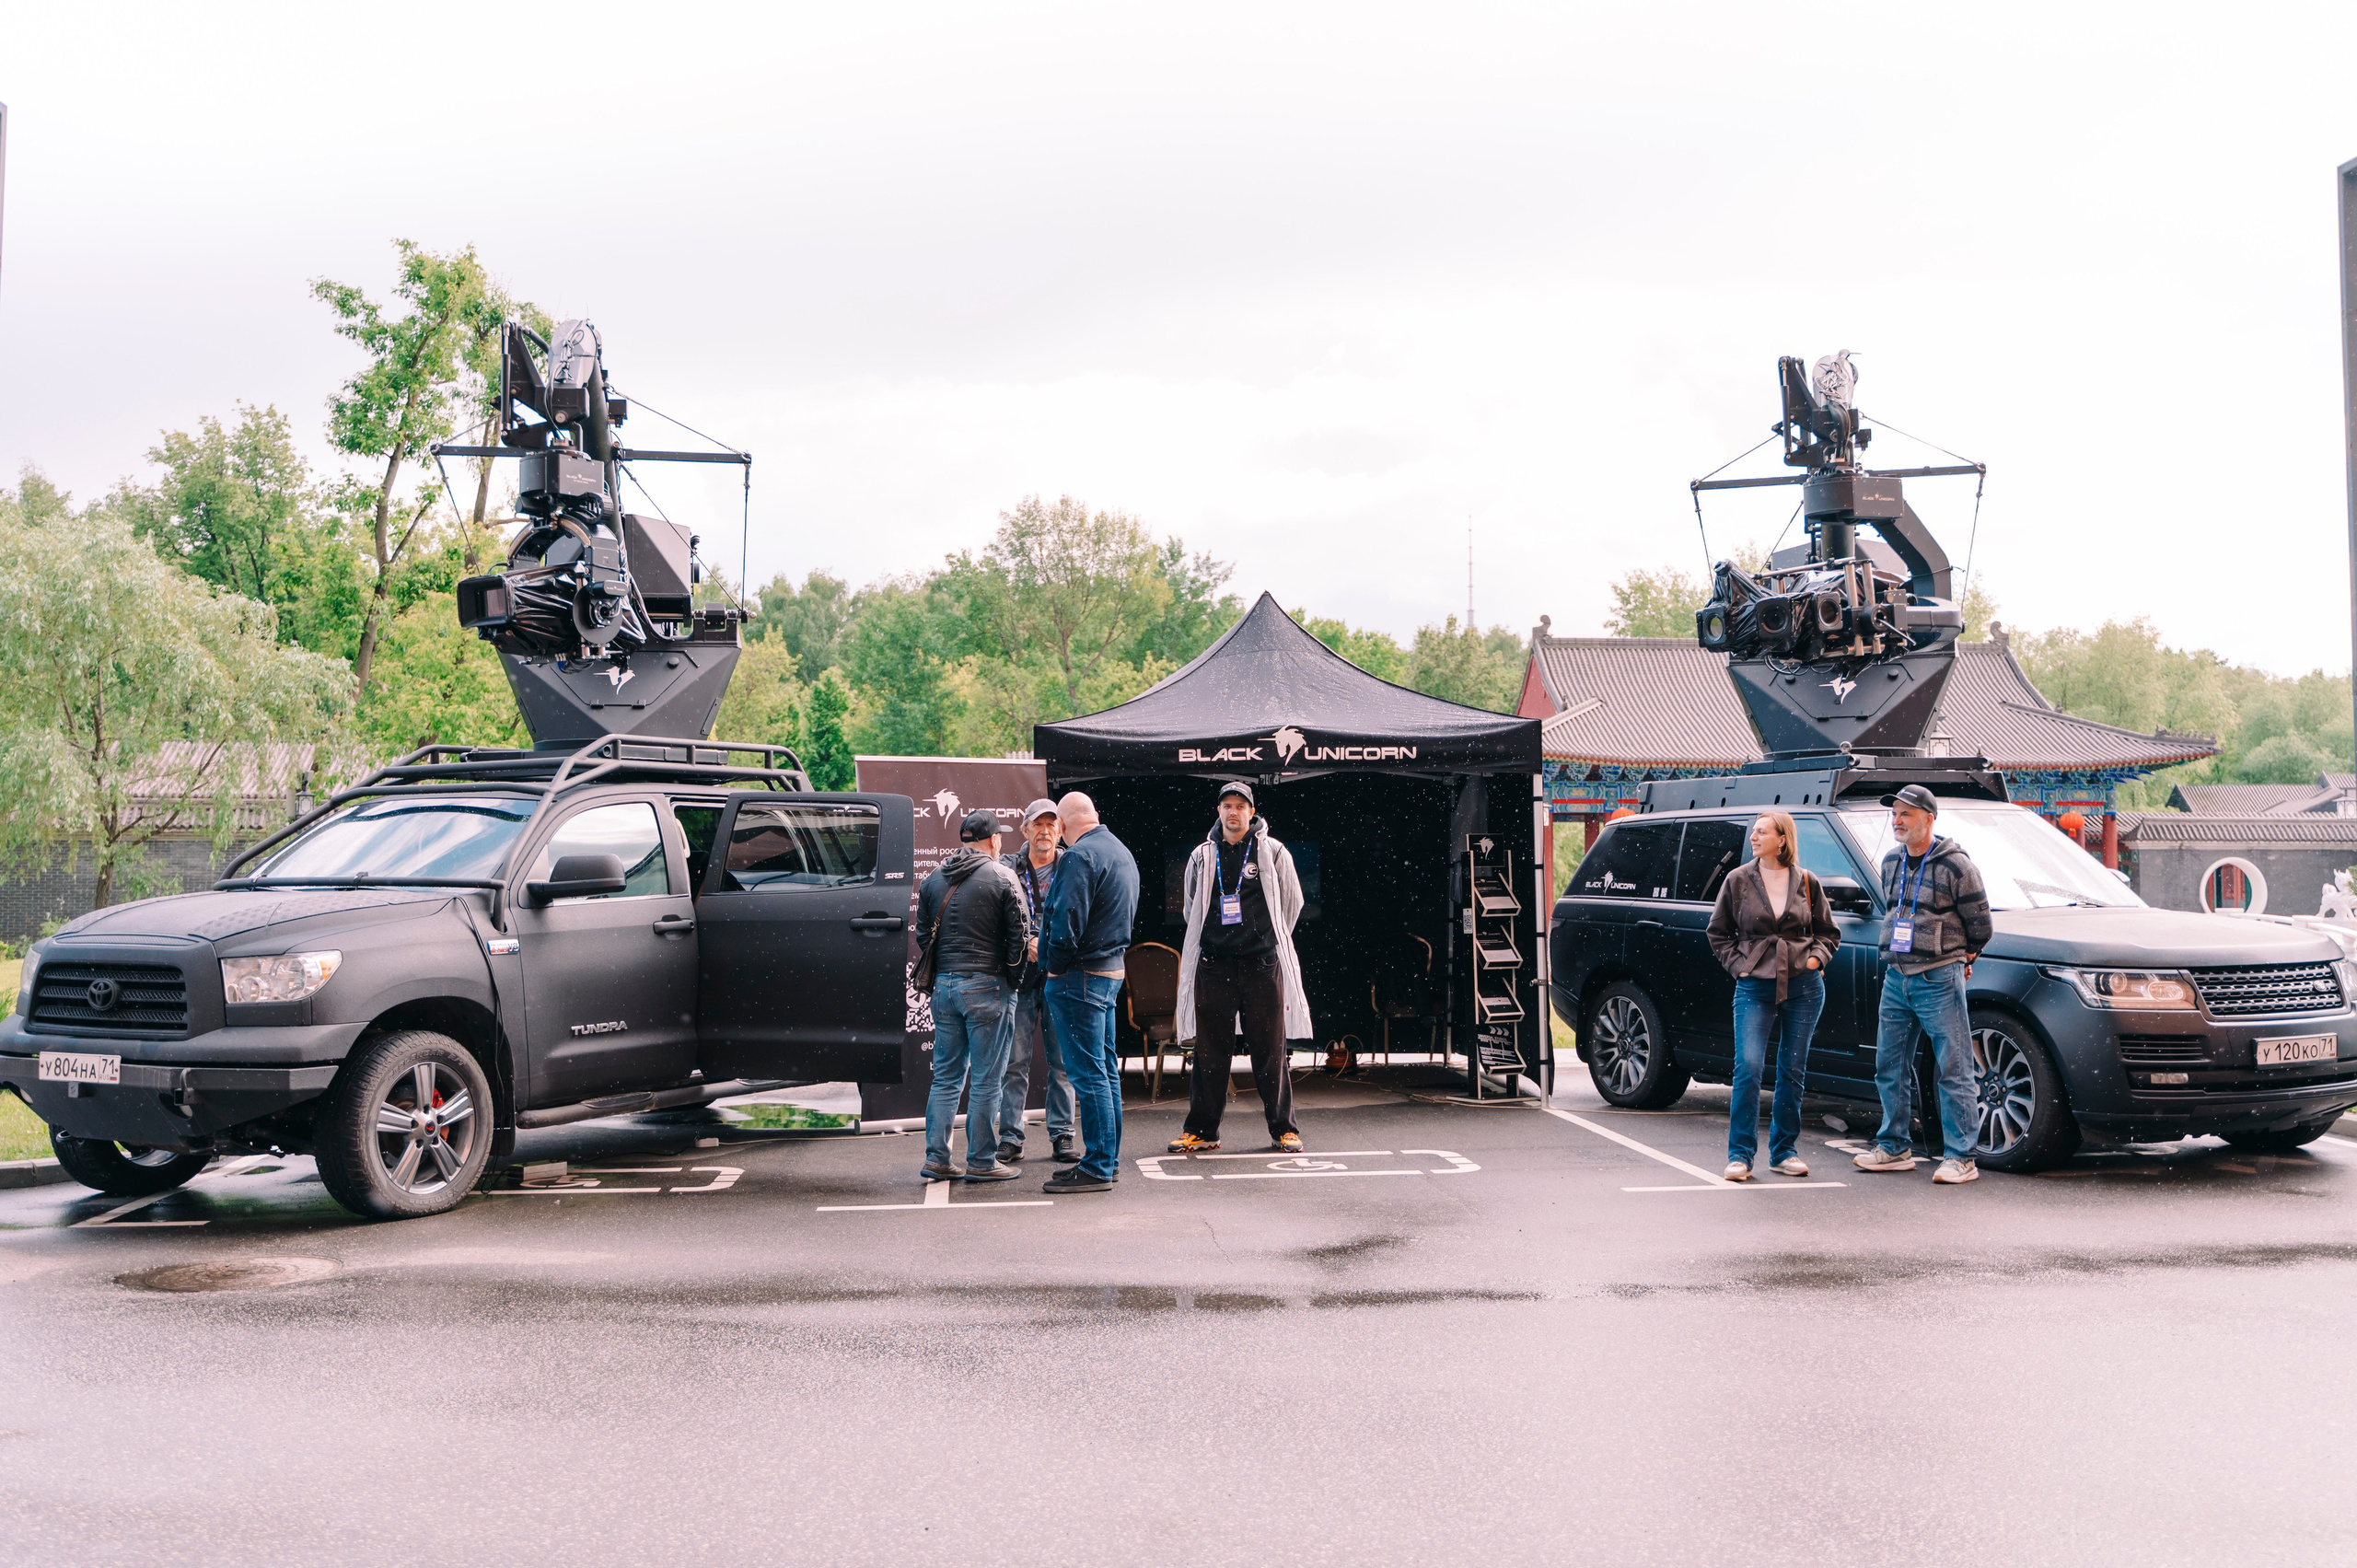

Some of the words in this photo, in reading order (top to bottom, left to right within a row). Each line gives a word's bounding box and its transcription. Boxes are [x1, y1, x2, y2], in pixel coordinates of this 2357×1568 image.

[1178, 747, 1263, 762] BLACK
[1304, 746, 1417, 761] UNICORN
[571, 1020, 628, 1036] TUNDRA
[2321, 1038, 2333, 1052] 71
[102, 1058, 115, 1074] 71
